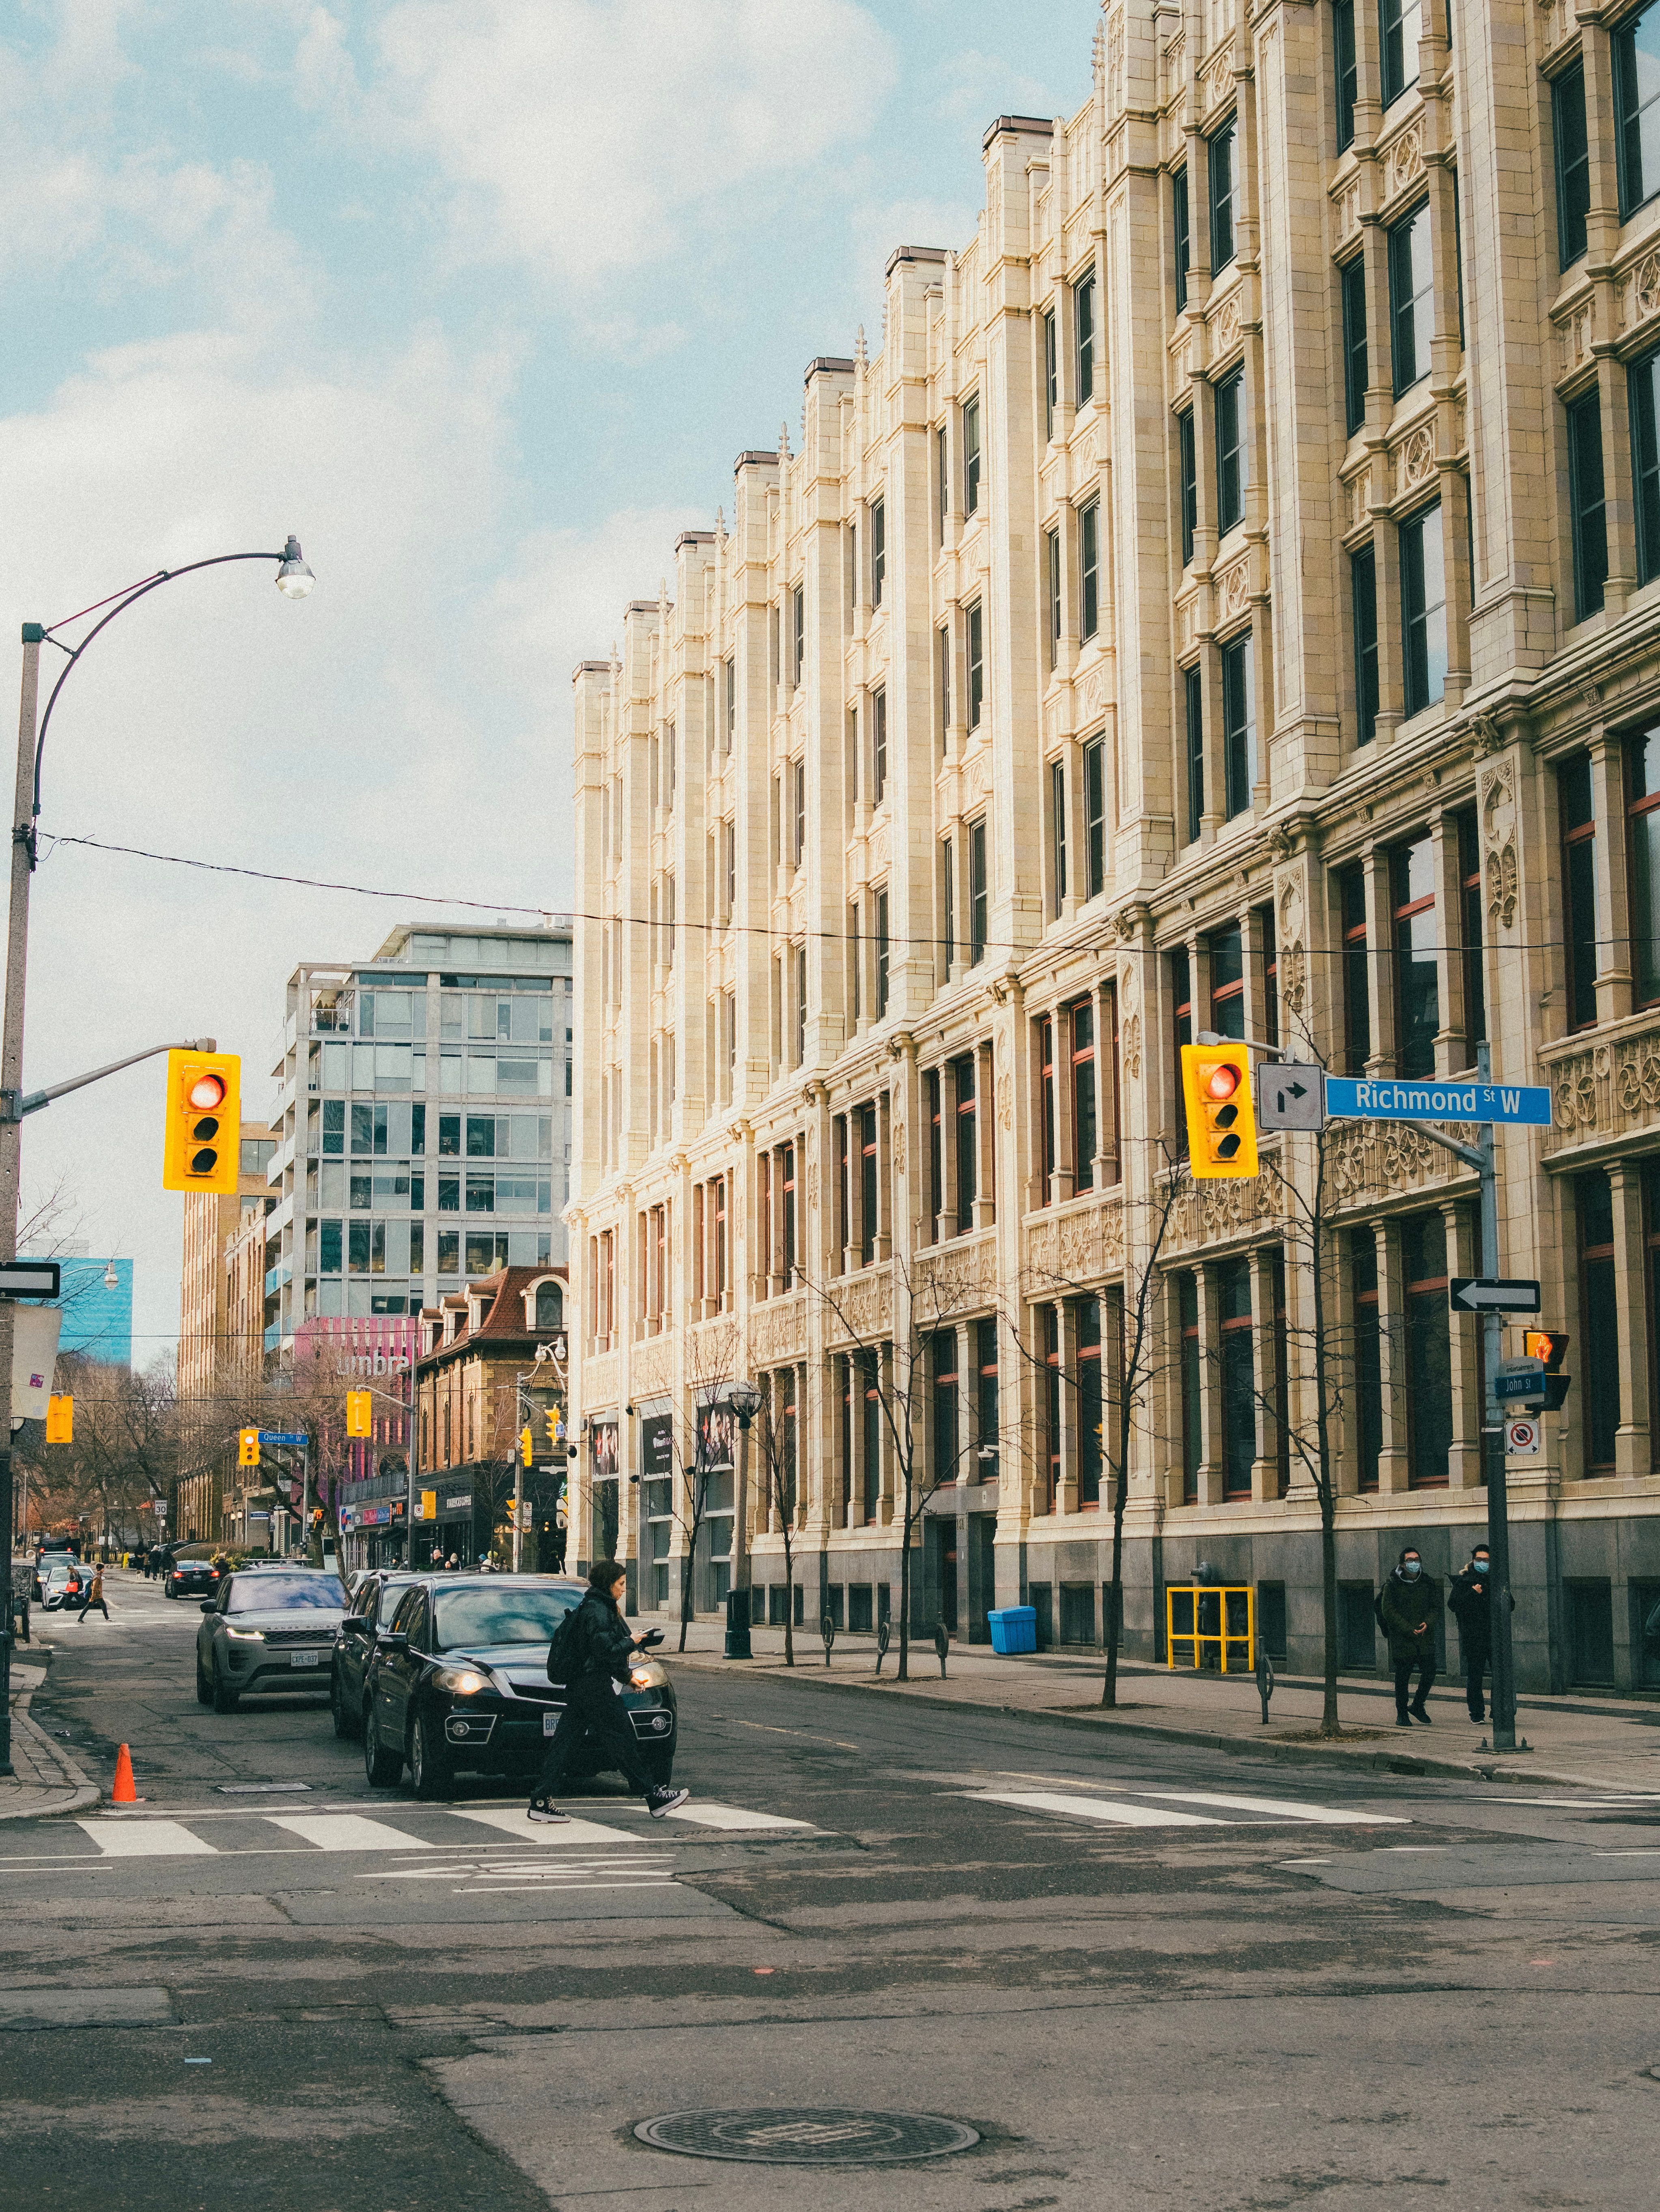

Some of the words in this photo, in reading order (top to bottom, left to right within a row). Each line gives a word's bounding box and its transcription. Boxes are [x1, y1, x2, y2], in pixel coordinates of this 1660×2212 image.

[1356, 1083, 1476, 1112] Richmond
[1483, 1089, 1495, 1102] St
[1501, 1090, 1520, 1114] W
[336, 1349, 409, 1376] umbra
[1506, 1378, 1522, 1392] John
[1526, 1379, 1531, 1388] St
